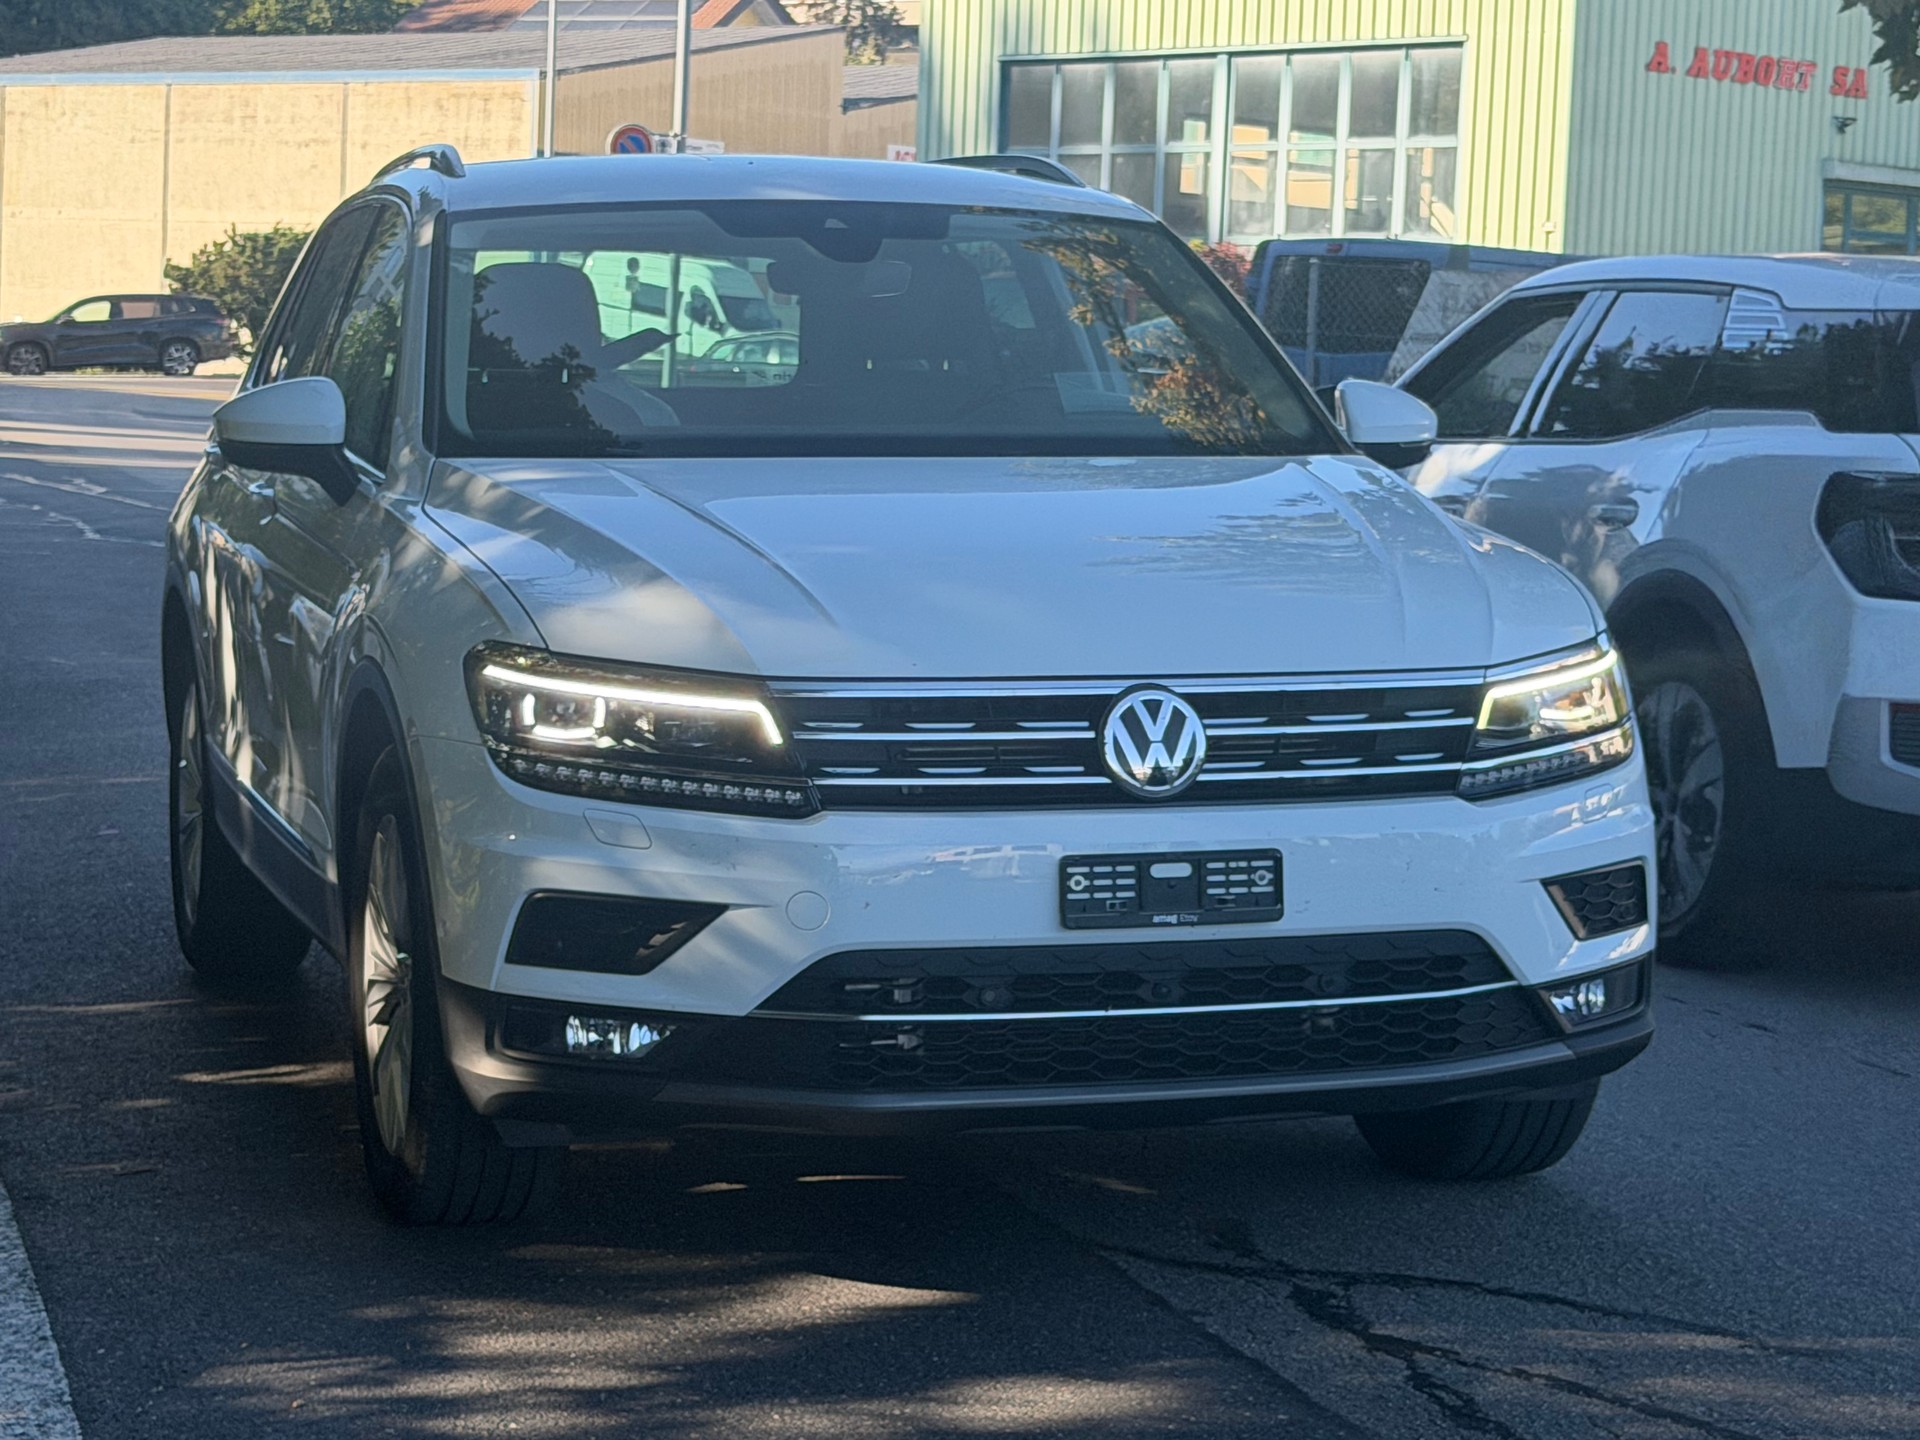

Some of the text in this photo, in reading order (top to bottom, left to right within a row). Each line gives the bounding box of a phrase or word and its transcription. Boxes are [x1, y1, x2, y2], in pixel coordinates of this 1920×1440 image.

[1645, 40, 1868, 99] A. AUBORT SA
